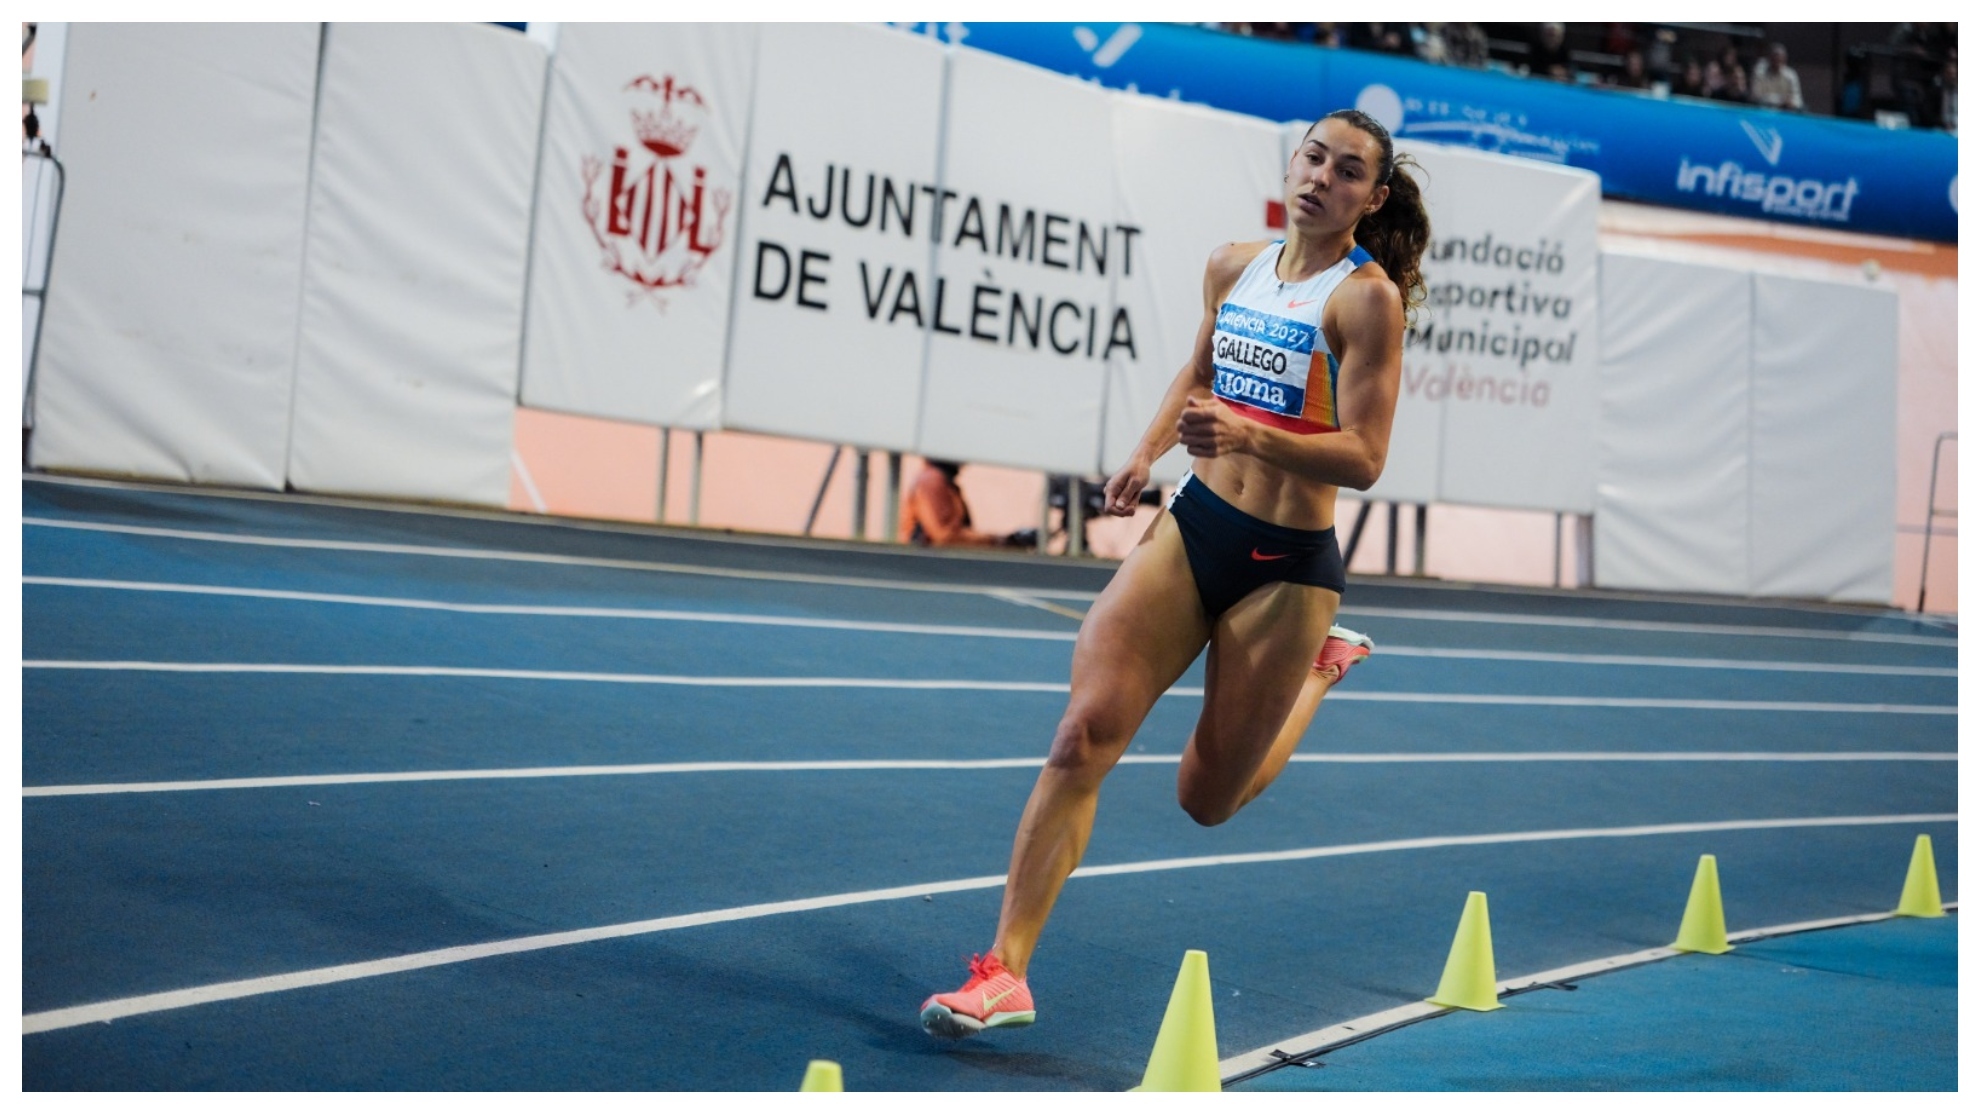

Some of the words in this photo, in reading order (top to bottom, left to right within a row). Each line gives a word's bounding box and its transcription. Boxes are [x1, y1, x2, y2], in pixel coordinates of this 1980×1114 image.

[1676, 157, 1860, 214] infisport
[761, 153, 1142, 276] AJUNTAMENT
[1430, 233, 1564, 274] undació
[754, 240, 831, 311] DE
[859, 260, 1138, 361] VALÈNCIA
[1427, 275, 1572, 320] sportiva
[1217, 336, 1287, 375] GALLEGO
[1269, 322, 1310, 347] 2027
[1405, 320, 1577, 368] Municipal
[1219, 372, 1286, 407] Joma
